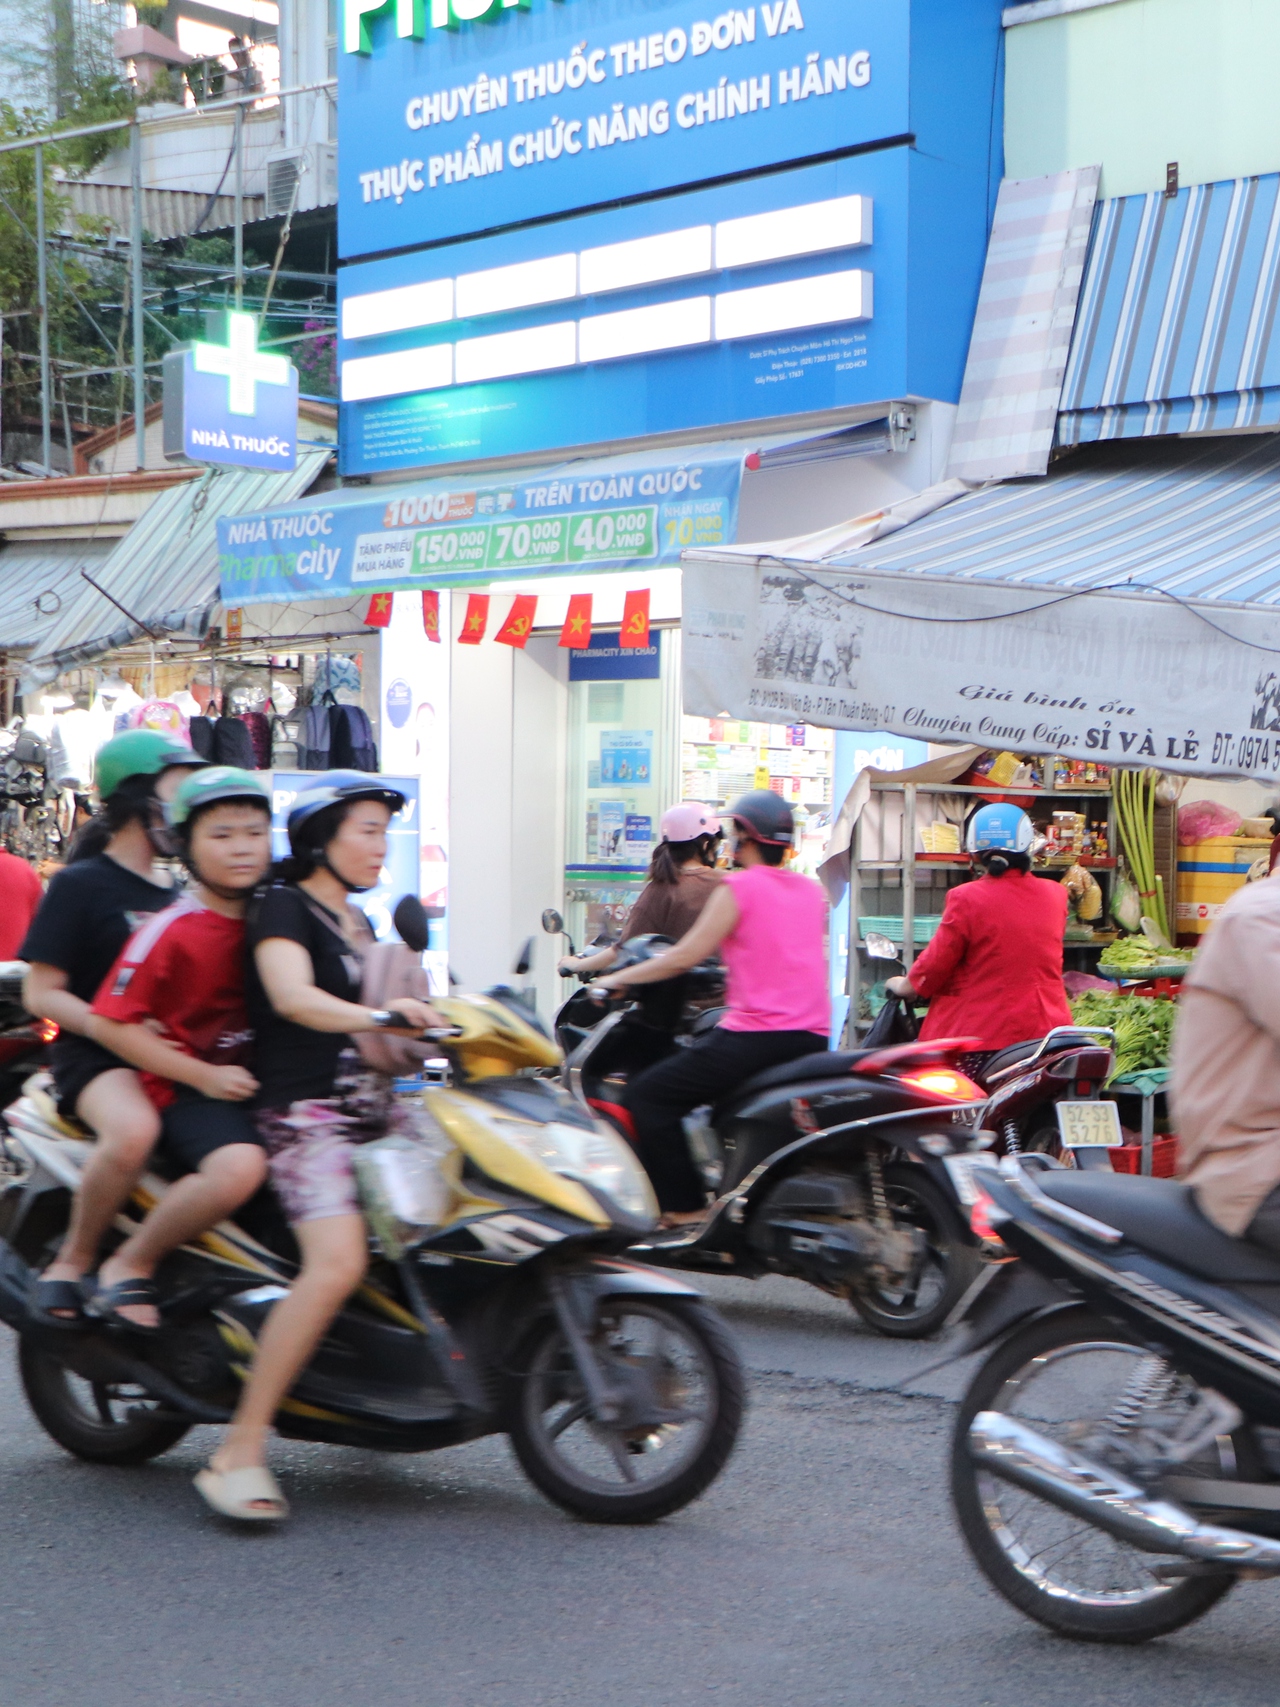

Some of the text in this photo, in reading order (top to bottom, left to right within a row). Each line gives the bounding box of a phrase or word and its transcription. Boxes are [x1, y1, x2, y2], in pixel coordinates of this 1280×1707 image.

[406, 73, 508, 130] CHUYÊN
[512, 41, 606, 103] THUỐC
[610, 28, 687, 77] THEO
[691, 7, 756, 57] ĐƠN
[359, 50, 871, 204] THỰC PHẨM CHỨC NĂNG CHÍNH HÃNG
[191, 429, 290, 457] NHÀ THUỐC
[525, 463, 703, 509] TRÊN TOÀN QUỐC
[389, 492, 449, 526] 1000
[228, 509, 334, 545] NHÀ THUỐC
[495, 524, 531, 560] 70
[573, 515, 614, 552] 40
[356, 560, 376, 573] MUA
[378, 557, 405, 571] HÀNG
[416, 532, 458, 565] 150
[572, 648, 619, 658] PHARMACITY
[620, 647, 634, 656] XIN
[956, 683, 1137, 716] Giá bình ổn
[903, 706, 971, 734] Chuyên
[978, 715, 1027, 744] Cung
[1085, 720, 1109, 750] SỈ
[1119, 728, 1157, 758] VÀ
[1166, 729, 1199, 761] LẺ
[1237, 735, 1270, 770] 0974
[1066, 1104, 1110, 1123] 52-S3
[1069, 1124, 1113, 1143] 5276
